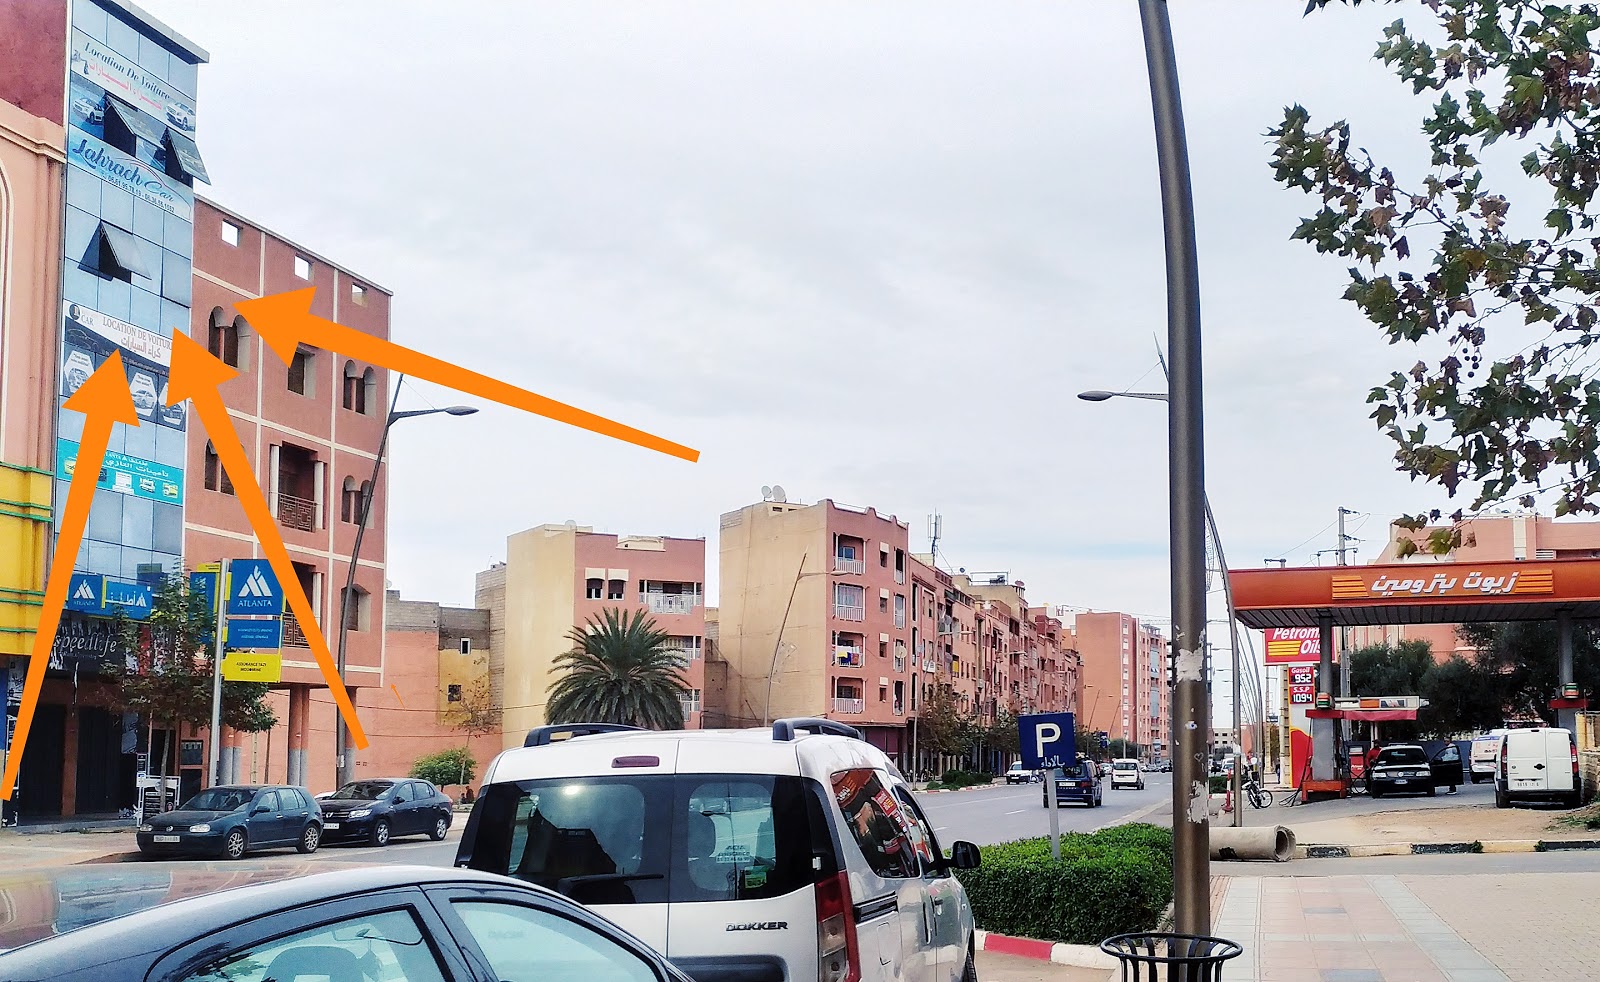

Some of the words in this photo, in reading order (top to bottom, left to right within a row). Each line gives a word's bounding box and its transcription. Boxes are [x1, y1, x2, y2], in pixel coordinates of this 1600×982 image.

[84, 42, 125, 73] Location
[126, 68, 139, 80] De
[140, 75, 170, 100] Voiture
[144, 181, 175, 202] Car
[81, 314, 94, 326] CAR
[103, 317, 137, 338] LOCATION
[138, 329, 146, 340] DE
[148, 331, 173, 351] VOITUR
[121, 336, 147, 354] السيارات
[1371, 573, 1458, 596] بترومين
[1463, 571, 1519, 594] زيوت
[237, 599, 273, 607] ATLANTA
[1272, 627, 1320, 640] Petrom
[1291, 666, 1310, 674] Gasoil
[1035, 722, 1061, 758] P
[725, 921, 788, 932] DOKKER
